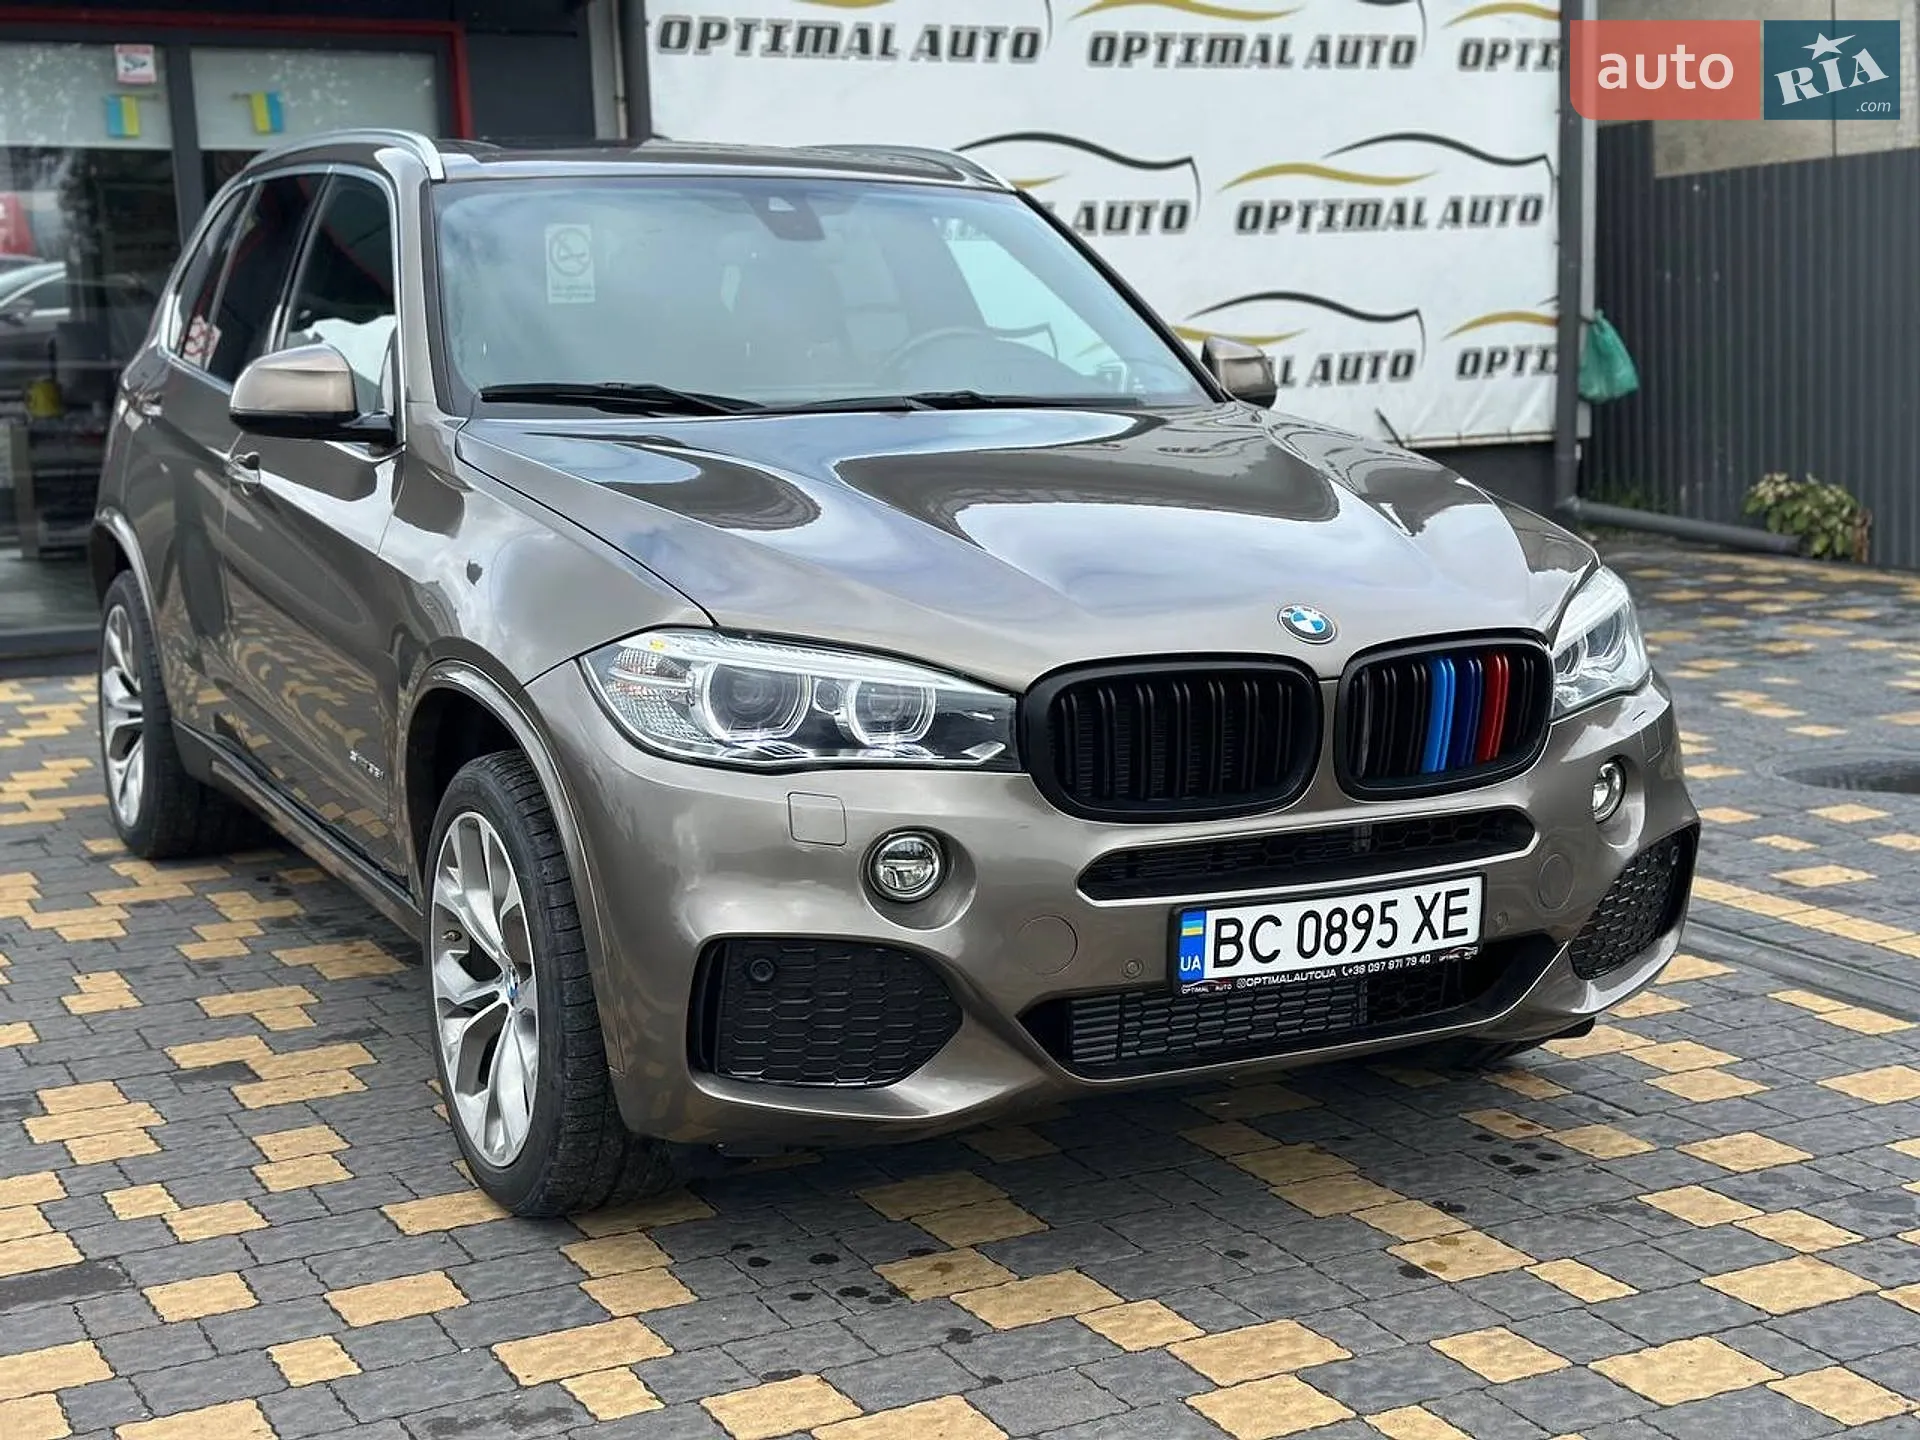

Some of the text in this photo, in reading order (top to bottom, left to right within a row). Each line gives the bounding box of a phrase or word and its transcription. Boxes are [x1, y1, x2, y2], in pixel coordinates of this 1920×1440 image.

[656, 14, 1042, 64] OPTIMAL AUTO
[1087, 31, 1417, 69] OPTIMAL AUTO
[1458, 37, 1560, 72] OPTI
[1072, 199, 1191, 236] AUTO
[1235, 193, 1544, 235] OPTIMAL AUTO
[1305, 349, 1417, 388] AUTO
[1456, 343, 1559, 381] OPTI
[1213, 888, 1470, 969] BC 0895 XE
[1180, 955, 1201, 972] UA
